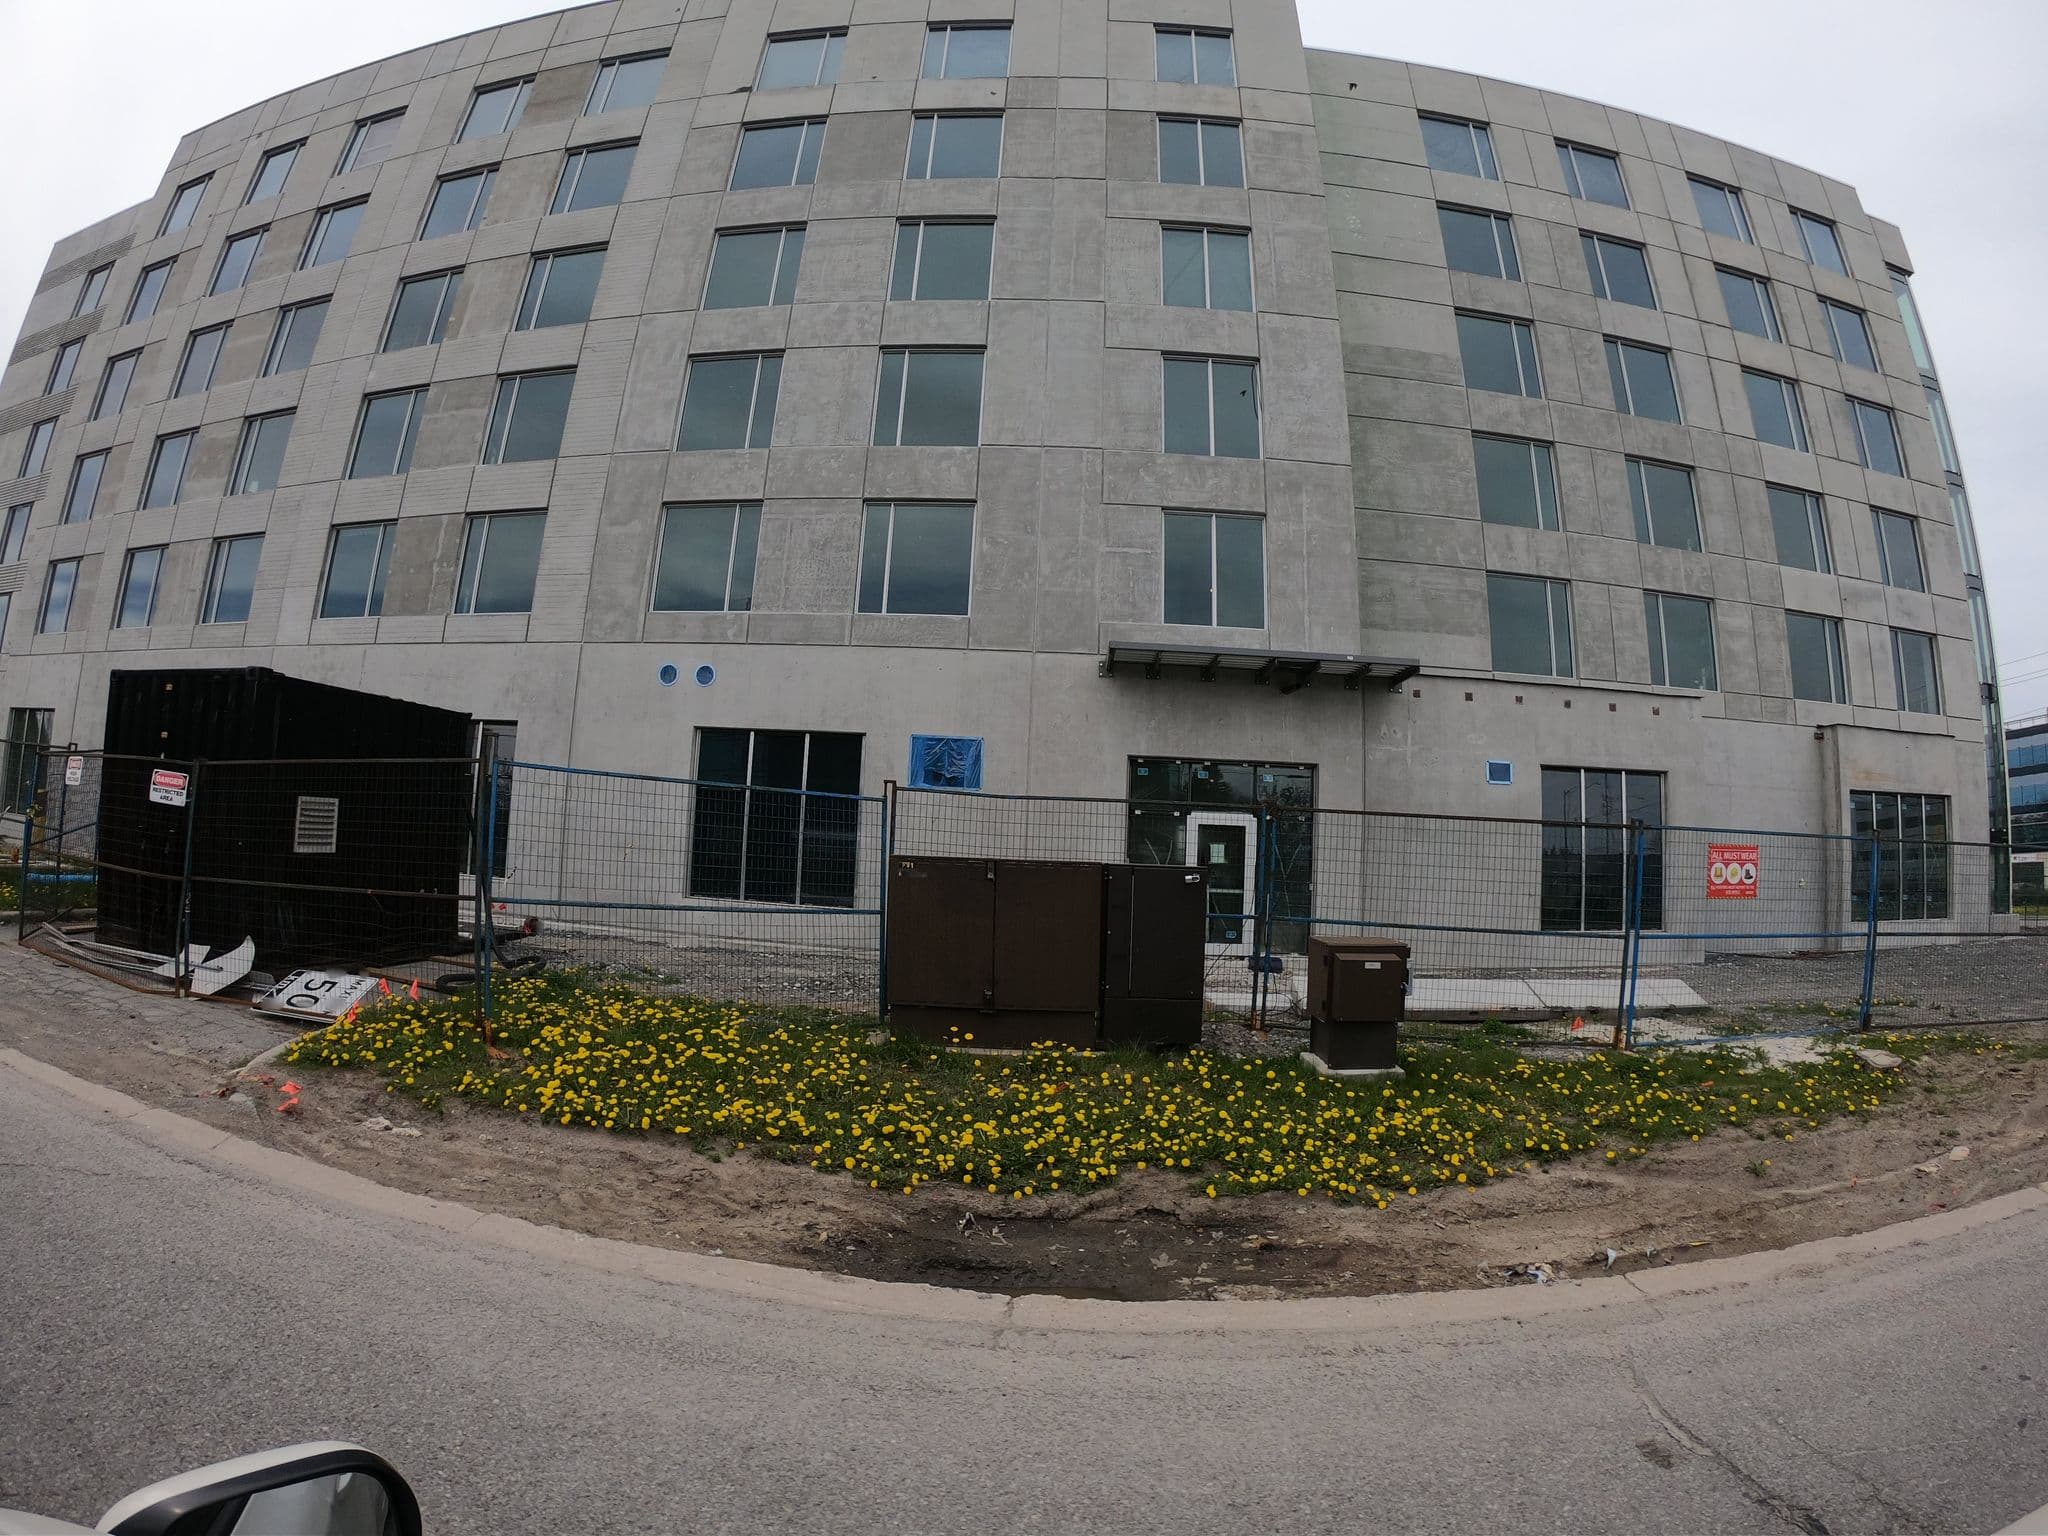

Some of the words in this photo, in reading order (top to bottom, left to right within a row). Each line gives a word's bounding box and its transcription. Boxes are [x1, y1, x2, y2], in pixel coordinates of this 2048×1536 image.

[156, 775, 184, 785] DANGER
[152, 787, 184, 796] RESTRICTED
[1712, 851, 1723, 860] ALL
[1723, 851, 1741, 860] MUST
[1741, 851, 1758, 860] WEAR
[286, 978, 338, 1008] 50
